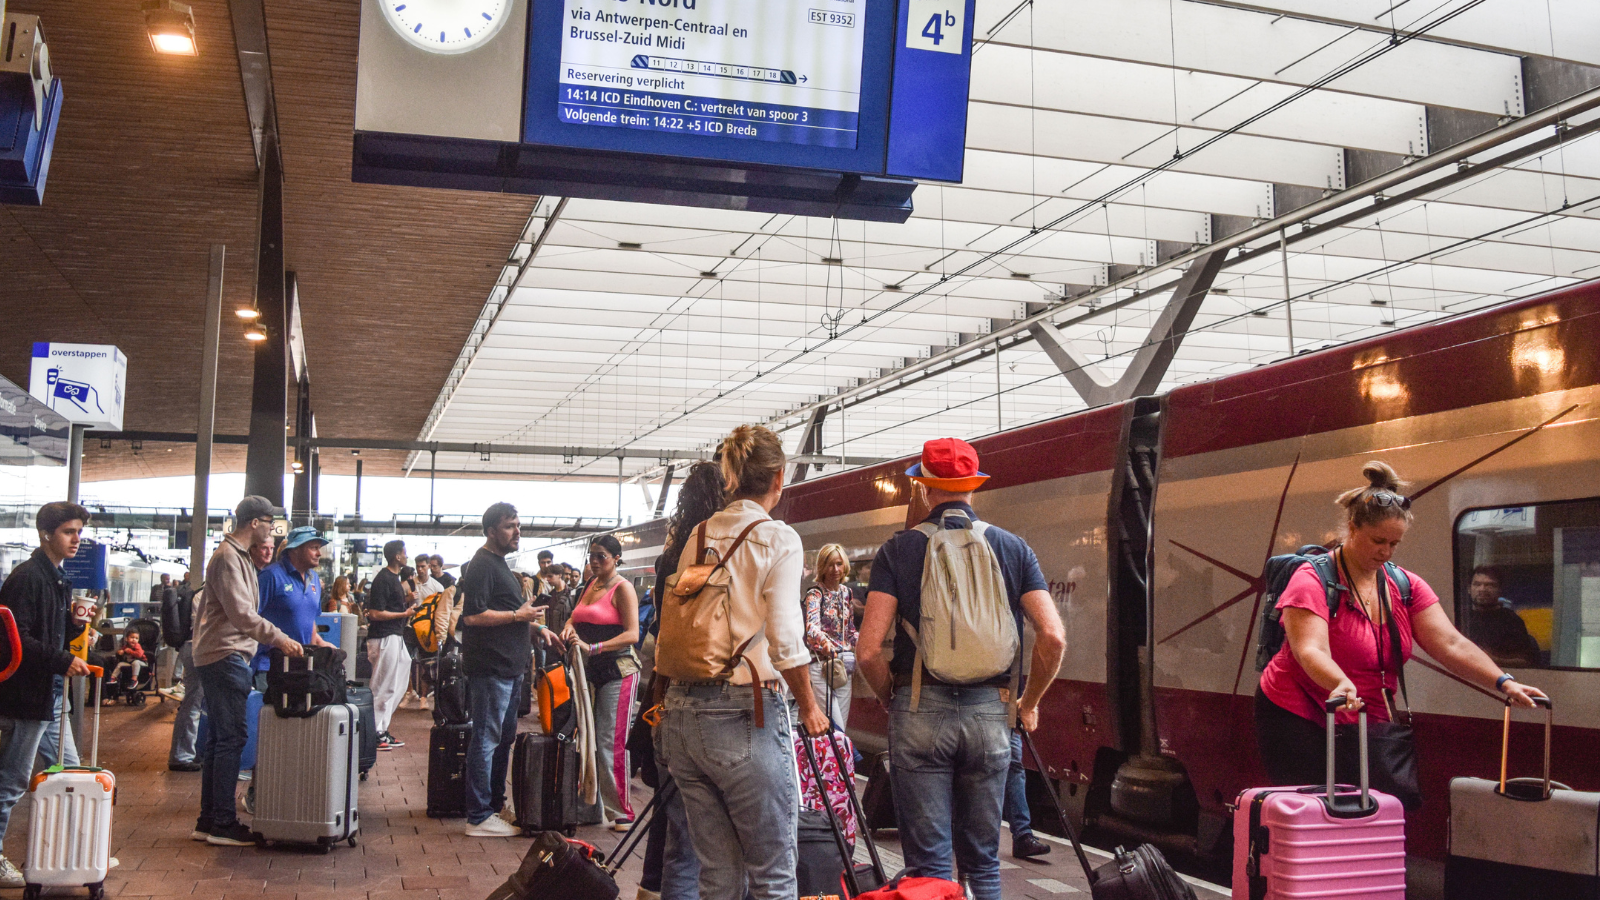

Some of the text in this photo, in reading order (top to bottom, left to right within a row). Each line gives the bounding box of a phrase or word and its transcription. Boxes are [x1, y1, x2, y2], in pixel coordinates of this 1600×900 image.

[640, 0, 696, 10] ord
[571, 7, 748, 38] via Antwerpen-Centraal en
[811, 11, 853, 26] EST 9352
[570, 26, 686, 50] Brussel-Zuid Midi
[567, 68, 685, 90] Reservering verplicht
[566, 88, 598, 102] 14:14
[601, 91, 620, 104] ICD
[623, 94, 681, 110] Eindhoven
[700, 103, 745, 116] vertrekt
[747, 108, 766, 118] van
[769, 111, 799, 122] spoor
[801, 111, 809, 122] 3
[564, 108, 757, 136] Volgende trein: 14:22 +5 ICD Breda
[51, 349, 107, 359] overstappen
